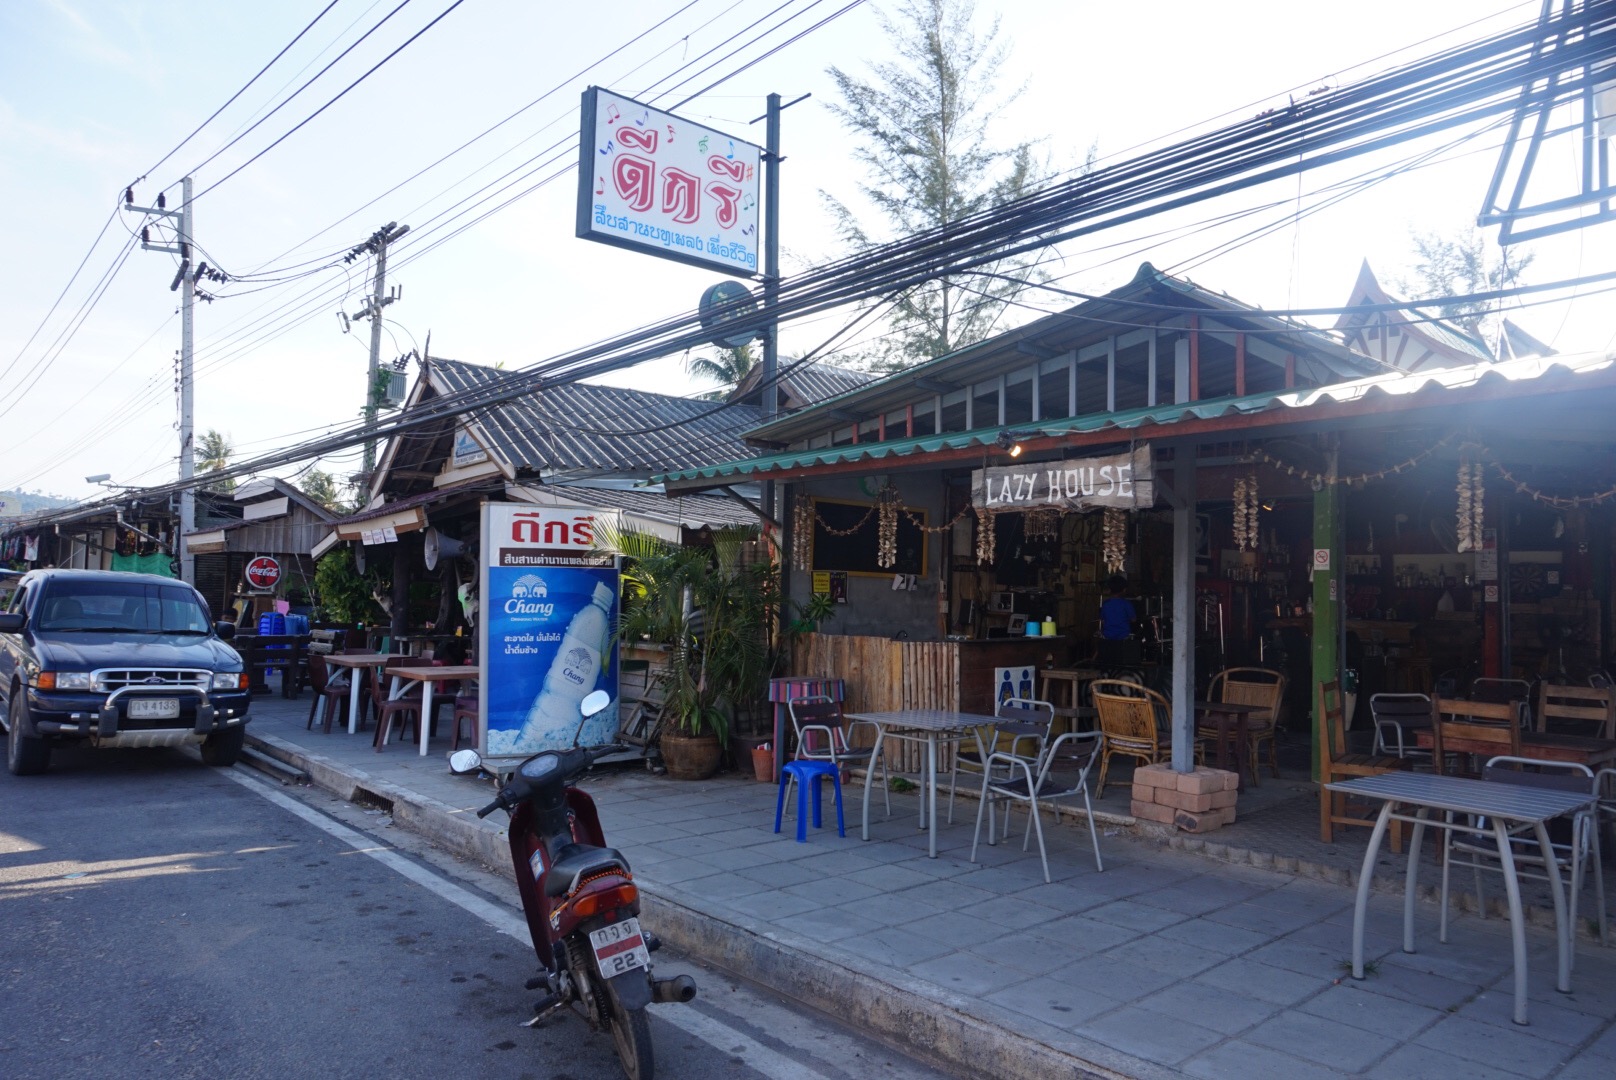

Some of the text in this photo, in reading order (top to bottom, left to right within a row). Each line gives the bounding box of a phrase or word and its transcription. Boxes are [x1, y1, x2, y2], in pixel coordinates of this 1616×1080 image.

[612, 126, 746, 230] ดีกรี
[986, 463, 1134, 506] LAZY HOUSE
[512, 512, 595, 545] ดีกรี
[249, 565, 279, 577] Coca-Cola
[504, 598, 555, 617] Chang
[562, 667, 585, 685] Chang
[612, 951, 636, 972] 22
